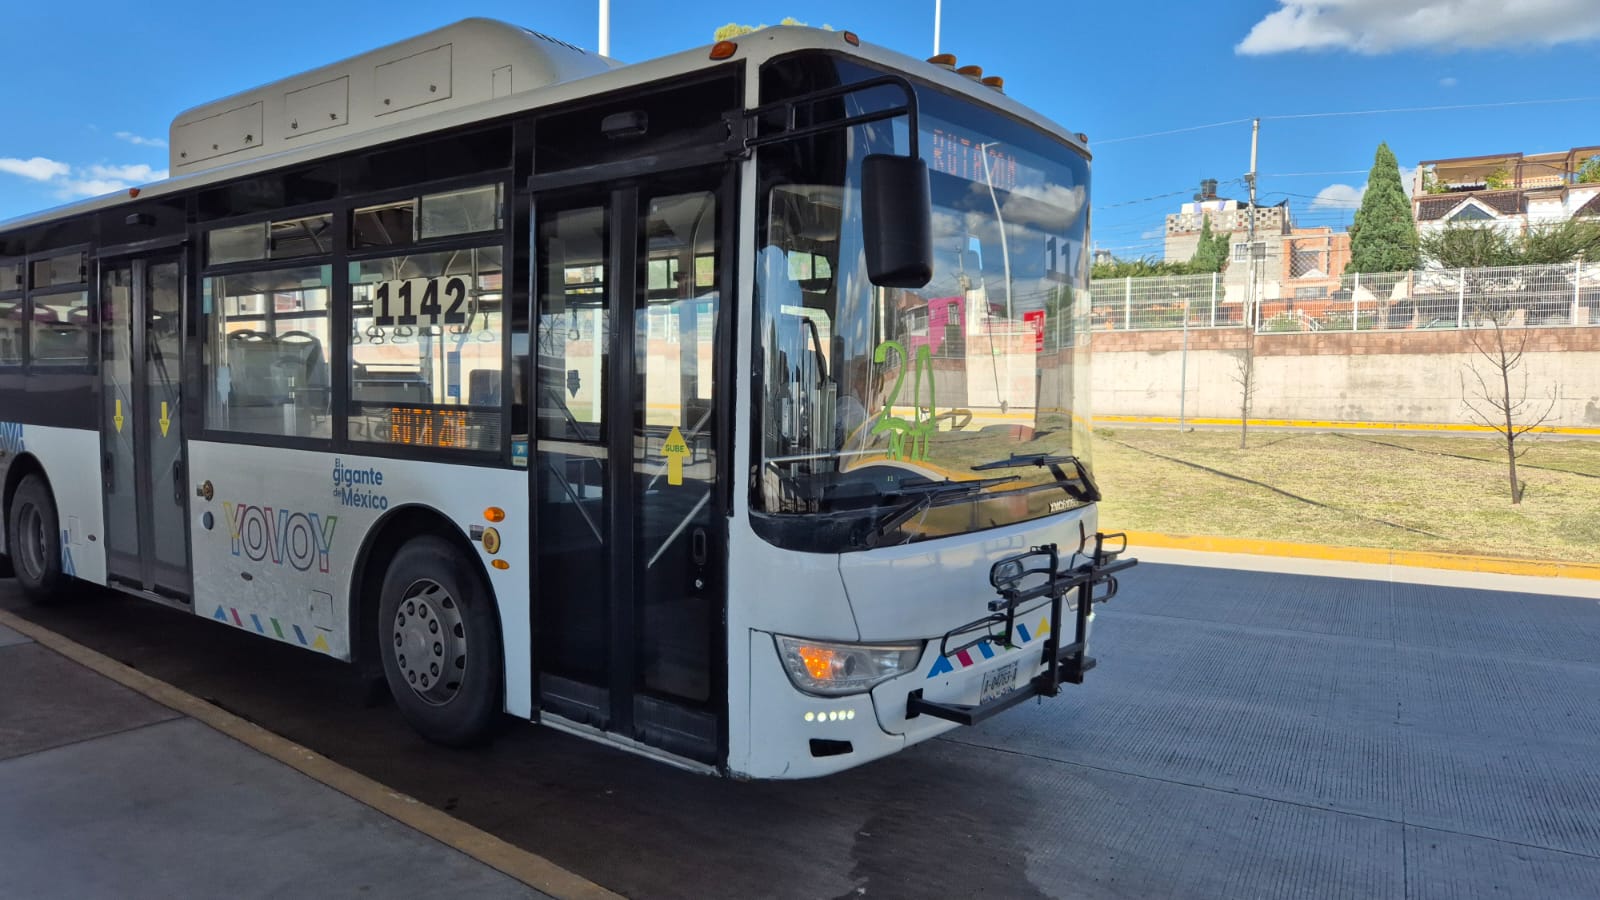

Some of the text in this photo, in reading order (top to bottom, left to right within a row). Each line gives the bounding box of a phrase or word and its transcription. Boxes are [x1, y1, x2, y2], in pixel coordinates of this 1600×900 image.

[376, 277, 466, 326] 1142
[871, 341, 936, 436] 20
[391, 407, 433, 446] RUTA
[335, 457, 341, 468] El
[665, 444, 685, 453] SUBE
[333, 463, 383, 488] gigante
[341, 487, 388, 510] México
[223, 501, 338, 573] YOVOY
